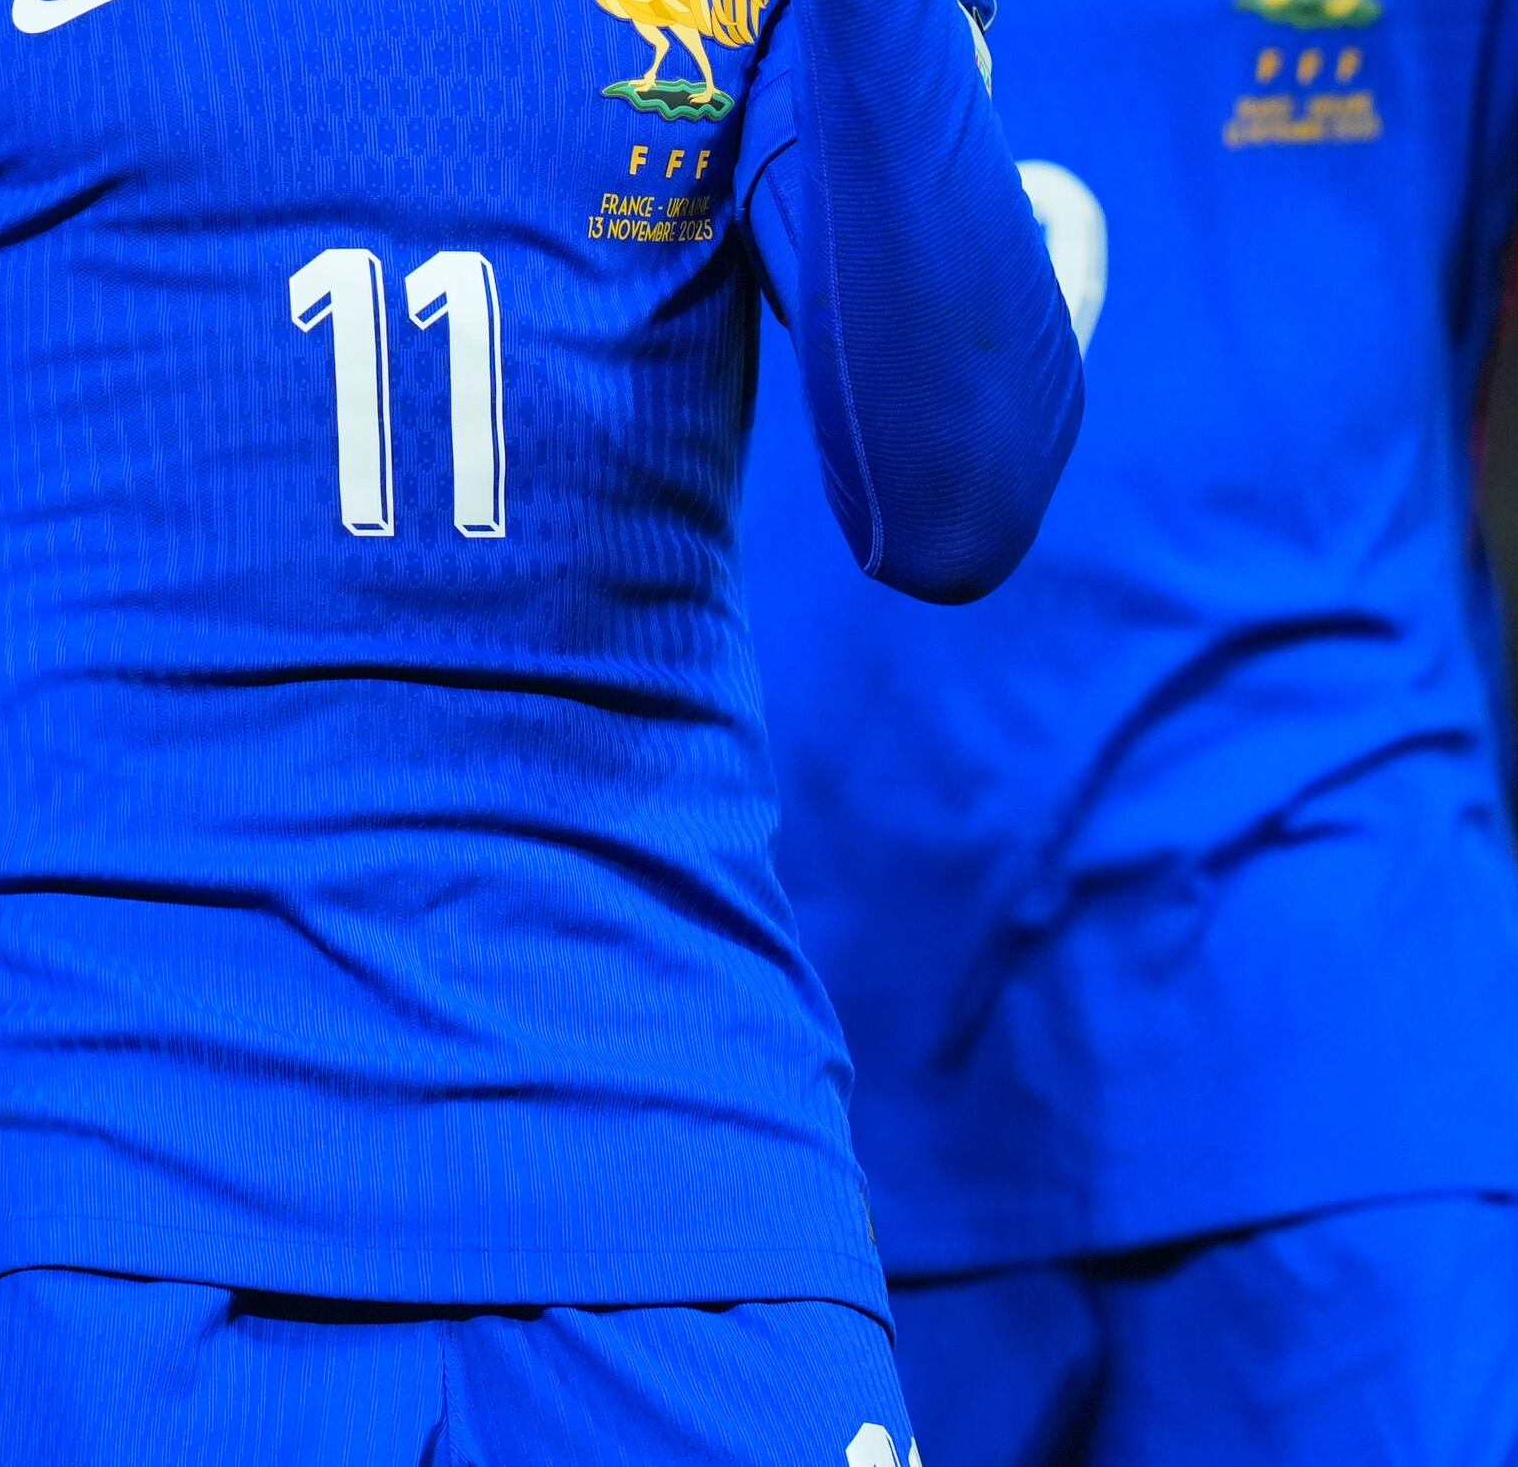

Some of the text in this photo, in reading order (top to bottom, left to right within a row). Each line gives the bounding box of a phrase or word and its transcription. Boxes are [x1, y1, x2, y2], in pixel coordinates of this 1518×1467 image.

[600, 193, 655, 217] FRANCE
[588, 216, 714, 242] 13 NOVEMBRE 2025
[288, 248, 507, 538] 11
